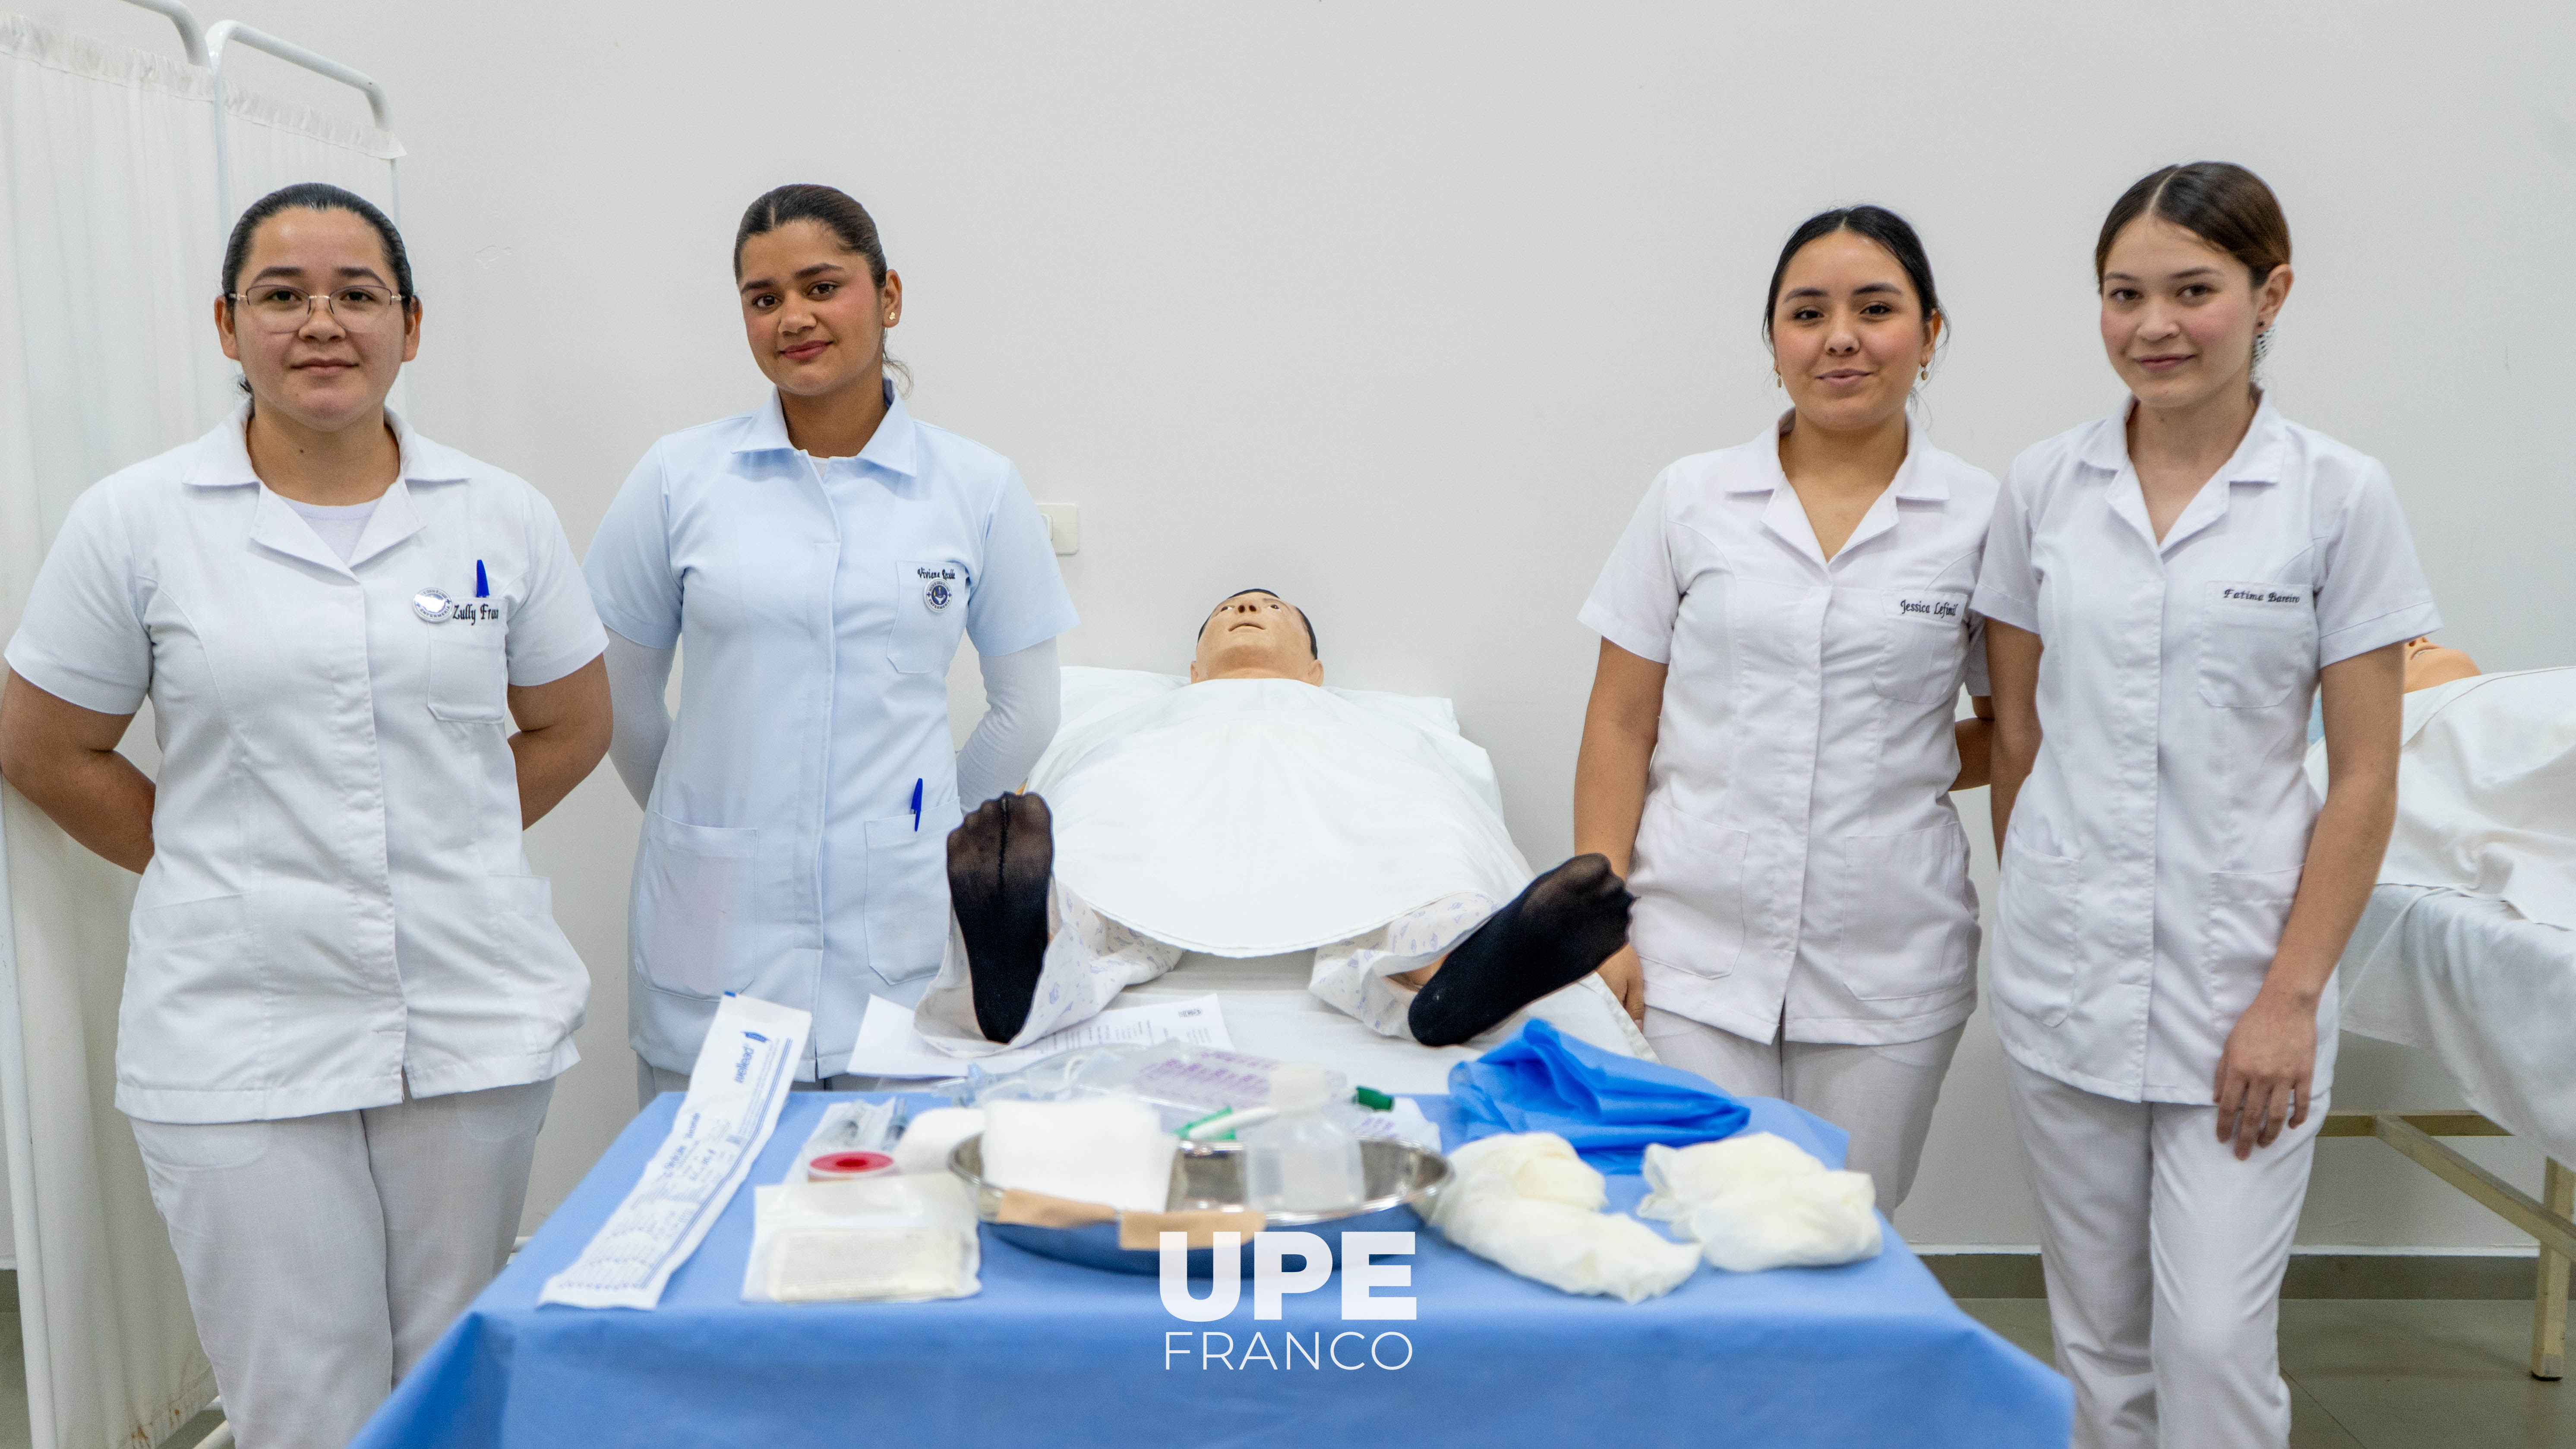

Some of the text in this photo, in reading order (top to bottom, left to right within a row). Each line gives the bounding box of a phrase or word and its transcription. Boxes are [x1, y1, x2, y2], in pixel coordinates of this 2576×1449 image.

[917, 567, 940, 579] Viviana
[2223, 588, 2264, 601] Fatima
[1900, 599, 1930, 614] Jessica
[452, 603, 476, 625] Zully
